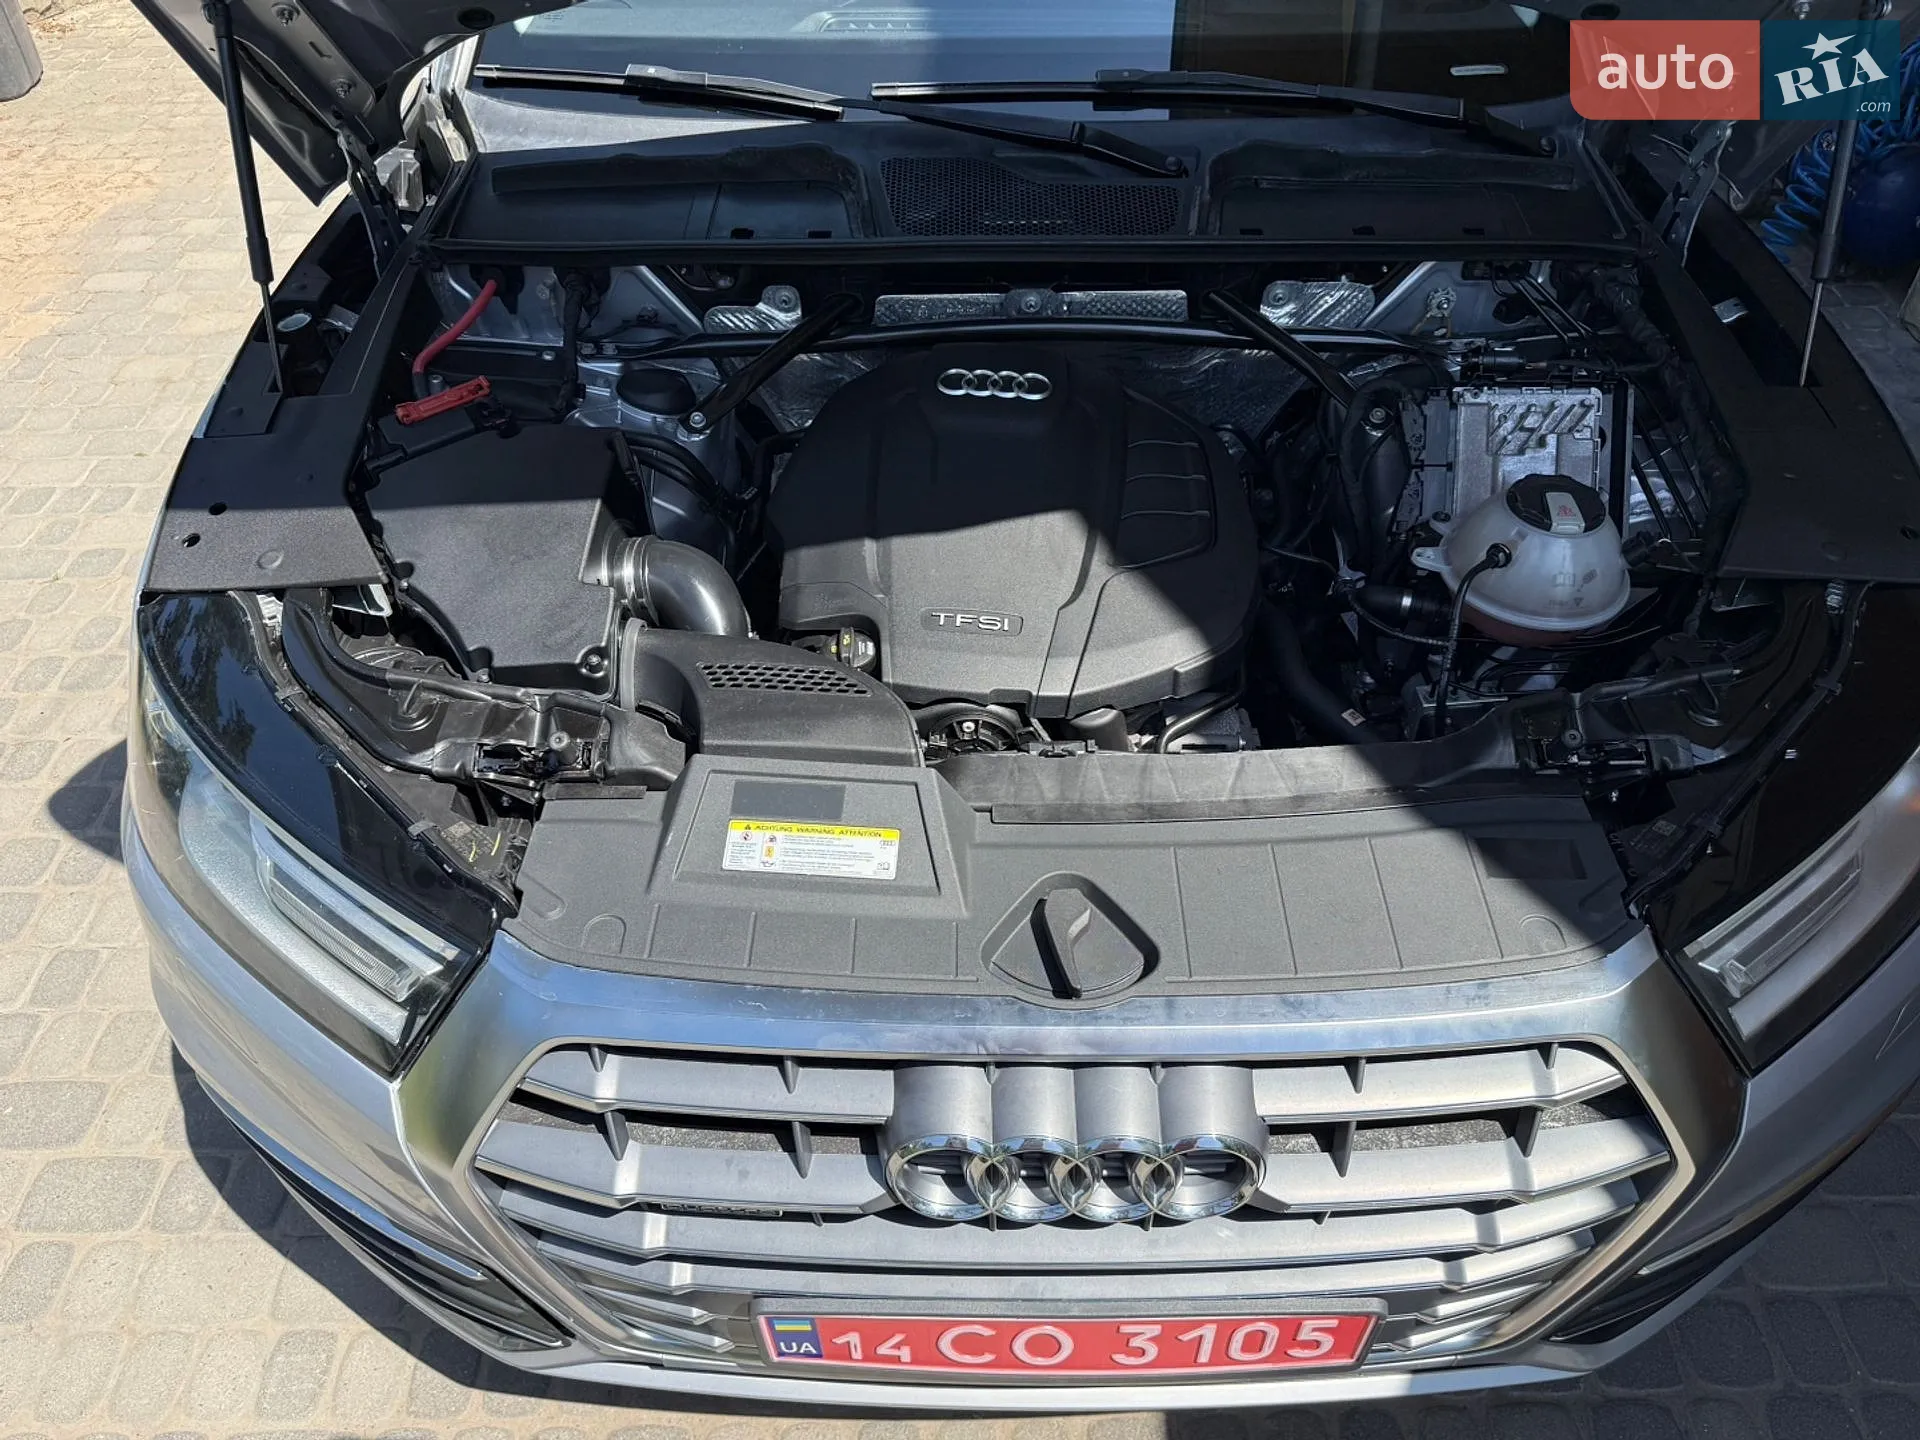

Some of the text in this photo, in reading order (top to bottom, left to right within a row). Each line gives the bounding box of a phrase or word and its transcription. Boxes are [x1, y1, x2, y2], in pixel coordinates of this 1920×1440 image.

[931, 612, 1009, 632] TFSI
[754, 825, 881, 838] ACHTUNG WARNING ATTENTION
[780, 1341, 817, 1354] UA
[831, 1319, 1339, 1366] 14 CO 3105
